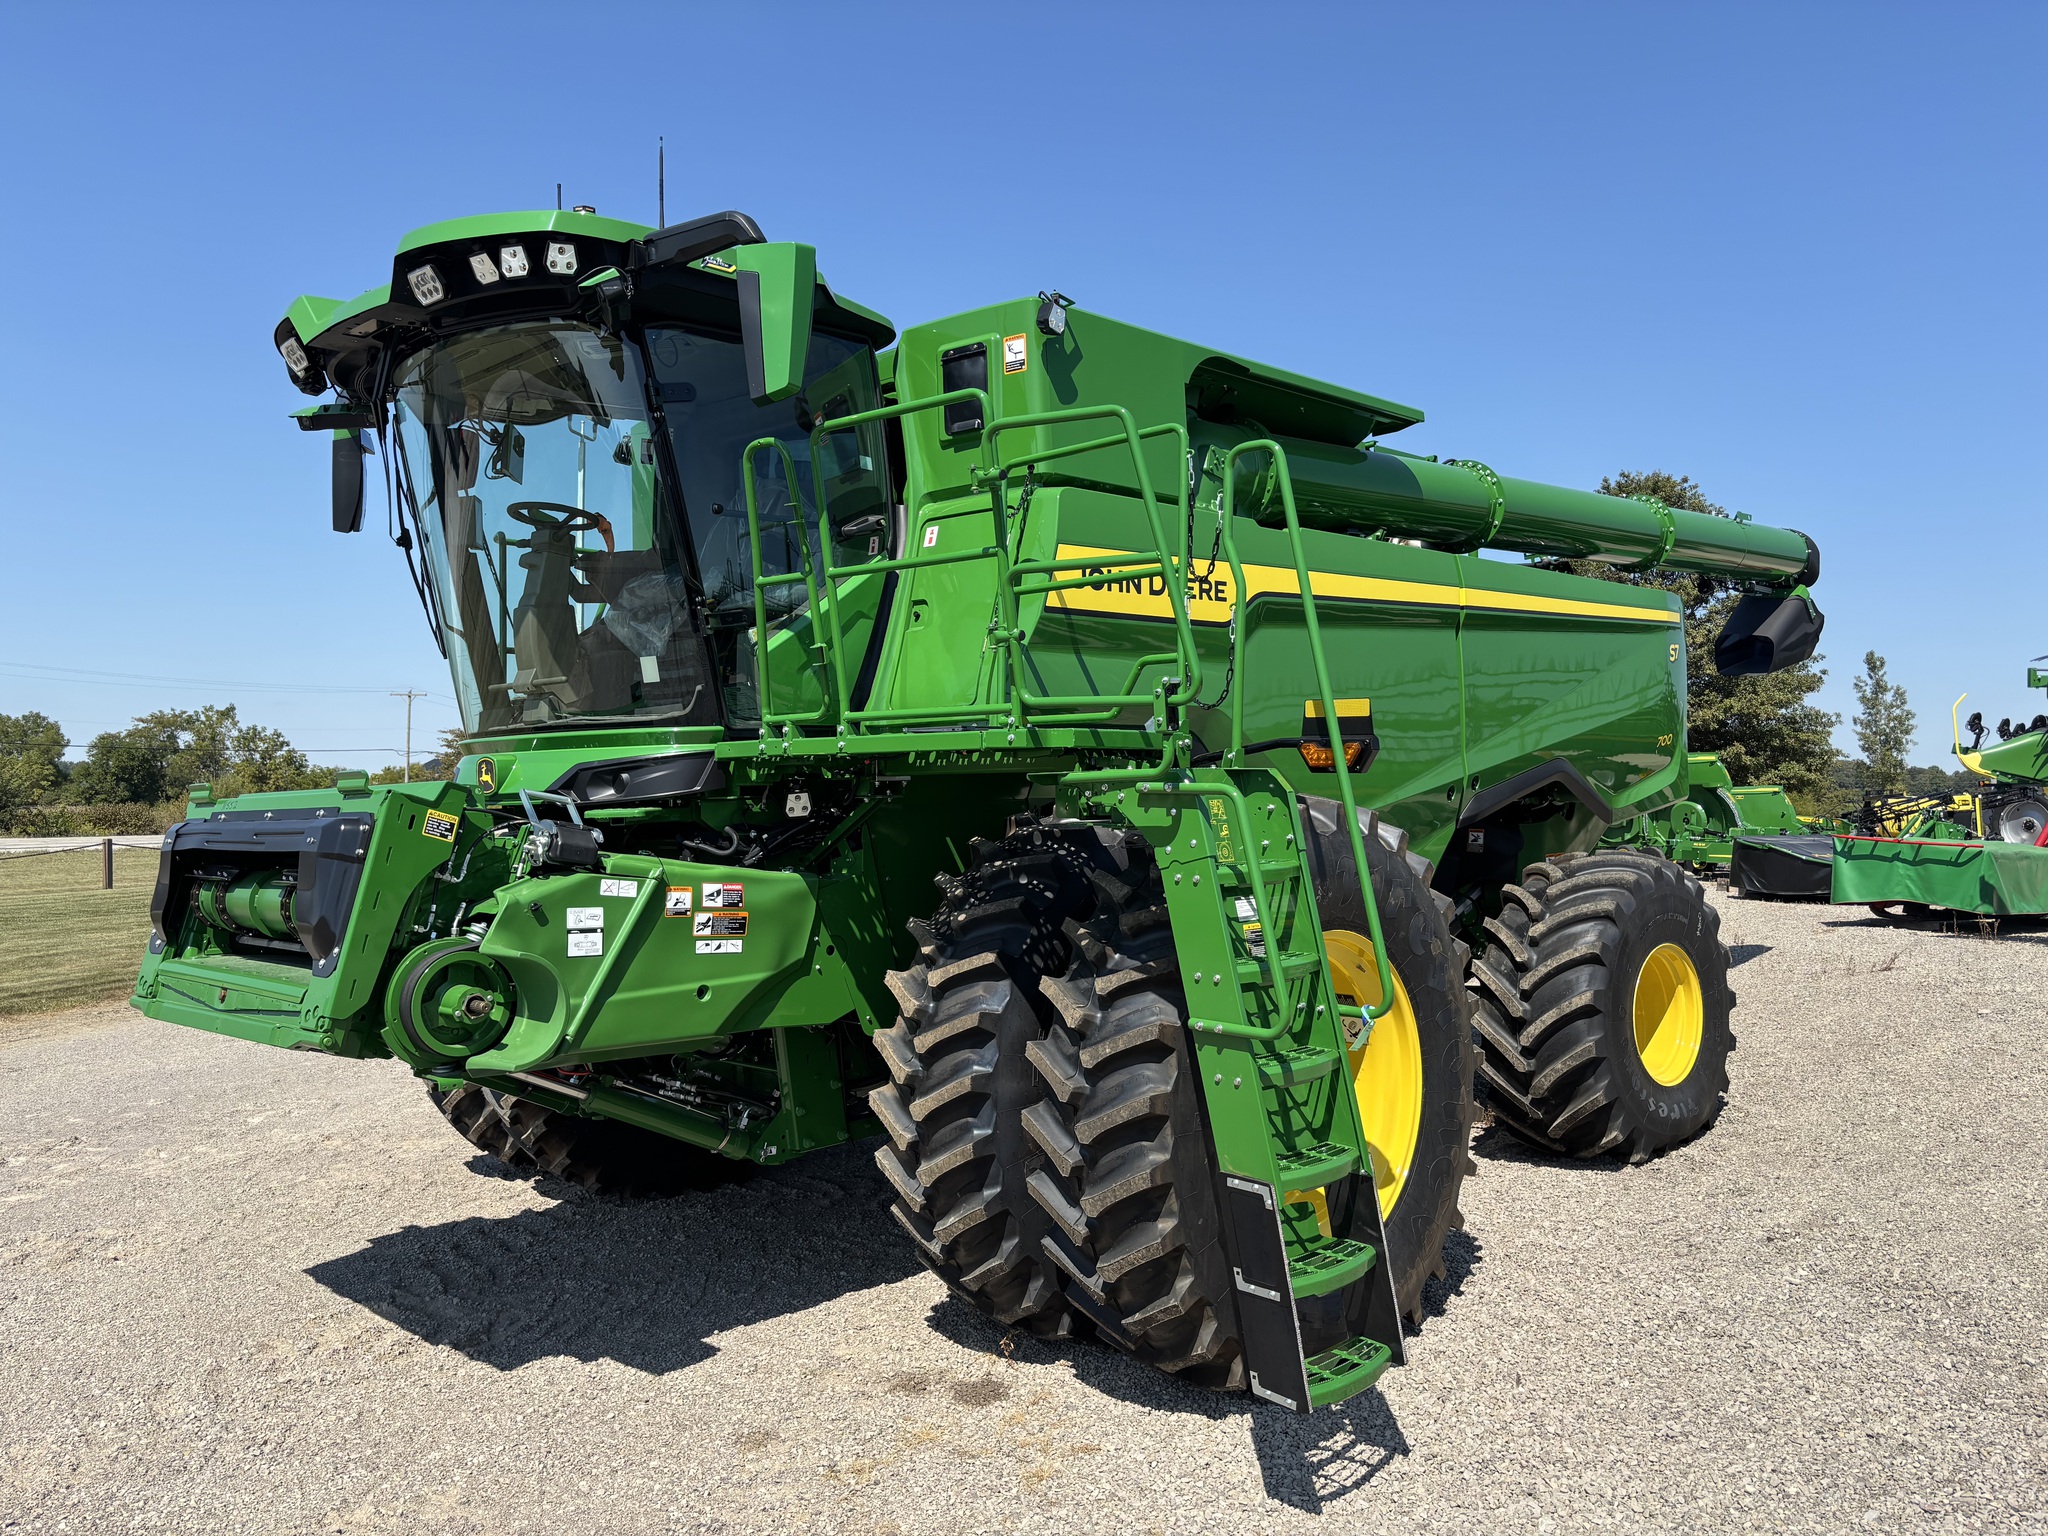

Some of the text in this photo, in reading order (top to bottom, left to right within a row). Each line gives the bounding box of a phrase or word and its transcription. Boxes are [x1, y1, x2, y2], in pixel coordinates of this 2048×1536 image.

[1149, 573, 1227, 602] DERE
[1669, 644, 1680, 662] S7
[1656, 733, 1673, 748] 700
[433, 811, 457, 822] CAUTION
